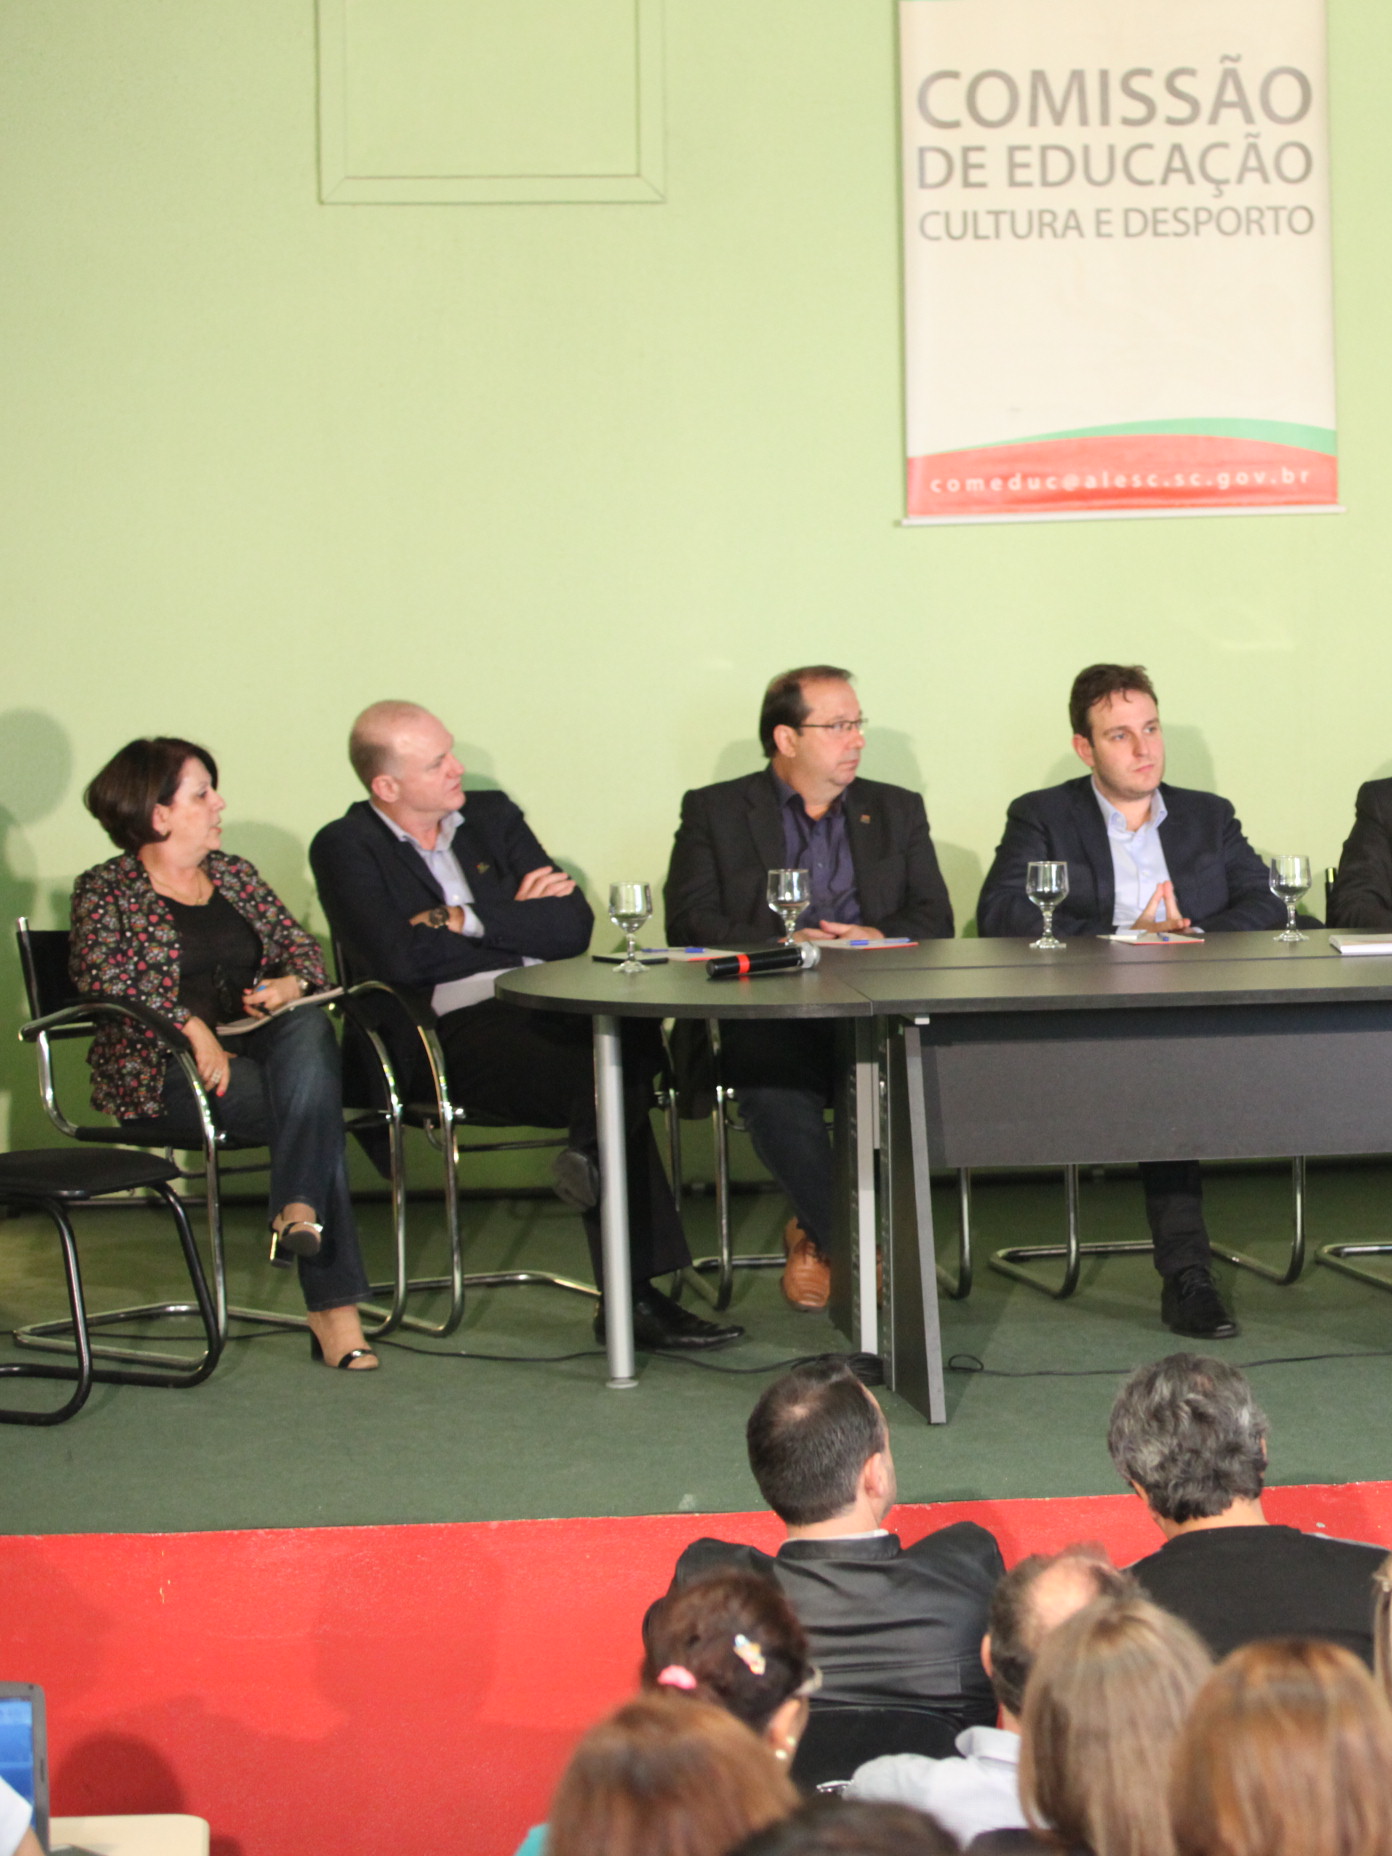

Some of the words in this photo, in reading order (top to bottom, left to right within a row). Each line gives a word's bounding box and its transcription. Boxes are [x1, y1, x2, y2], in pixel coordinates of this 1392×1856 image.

[917, 53, 1314, 130] COMISSÃO
[917, 144, 989, 190] DE
[1007, 131, 1315, 198] EDUCAÇÃO
[918, 208, 1086, 242] CULTURA
[1095, 208, 1114, 239] E
[1122, 204, 1316, 239] DESPORTO
[930, 466, 1312, 494] comeduc@alesc.sc.gov.br
